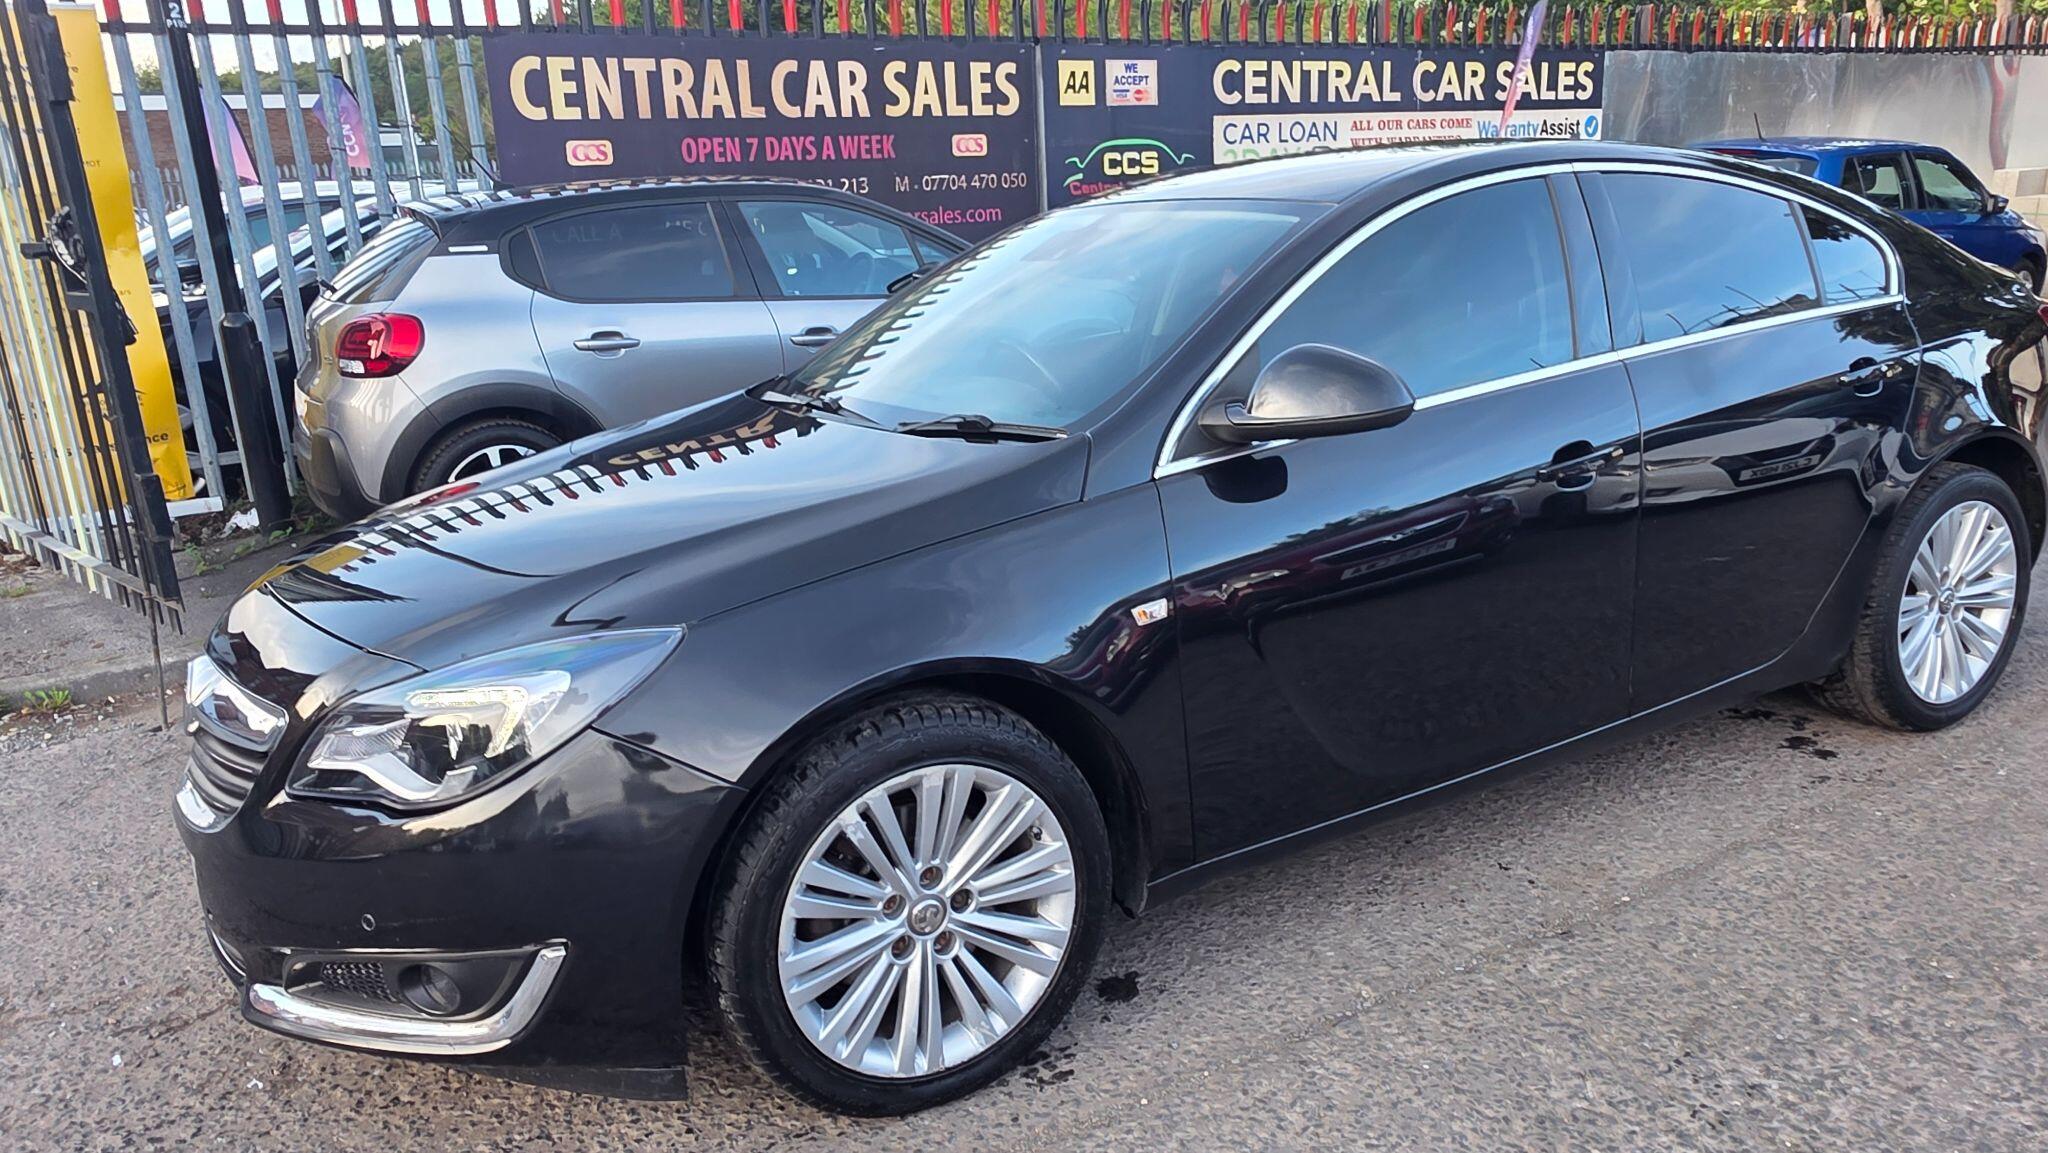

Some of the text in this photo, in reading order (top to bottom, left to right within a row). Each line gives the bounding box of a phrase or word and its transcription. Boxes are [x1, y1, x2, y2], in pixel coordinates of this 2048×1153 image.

[168, 2, 181, 19] 2
[1124, 63, 1138, 73] WE
[509, 55, 1020, 121] CENTRAL CAR SALES
[1064, 71, 1090, 94] AA
[1113, 75, 1149, 85] ACCEPT
[1213, 59, 1596, 105] CENTRAL CAR SALES
[1222, 120, 1338, 145] CAR LOAN
[1350, 117, 1473, 132] ALL OUR CARS COME
[681, 134, 896, 163] OPEN 7 DAYS A WEEK
[1103, 151, 1160, 176] CCS
[895, 175, 910, 193] M
[922, 174, 967, 191] 07704
[971, 173, 997, 189] 470
[1001, 172, 1027, 188] 050
